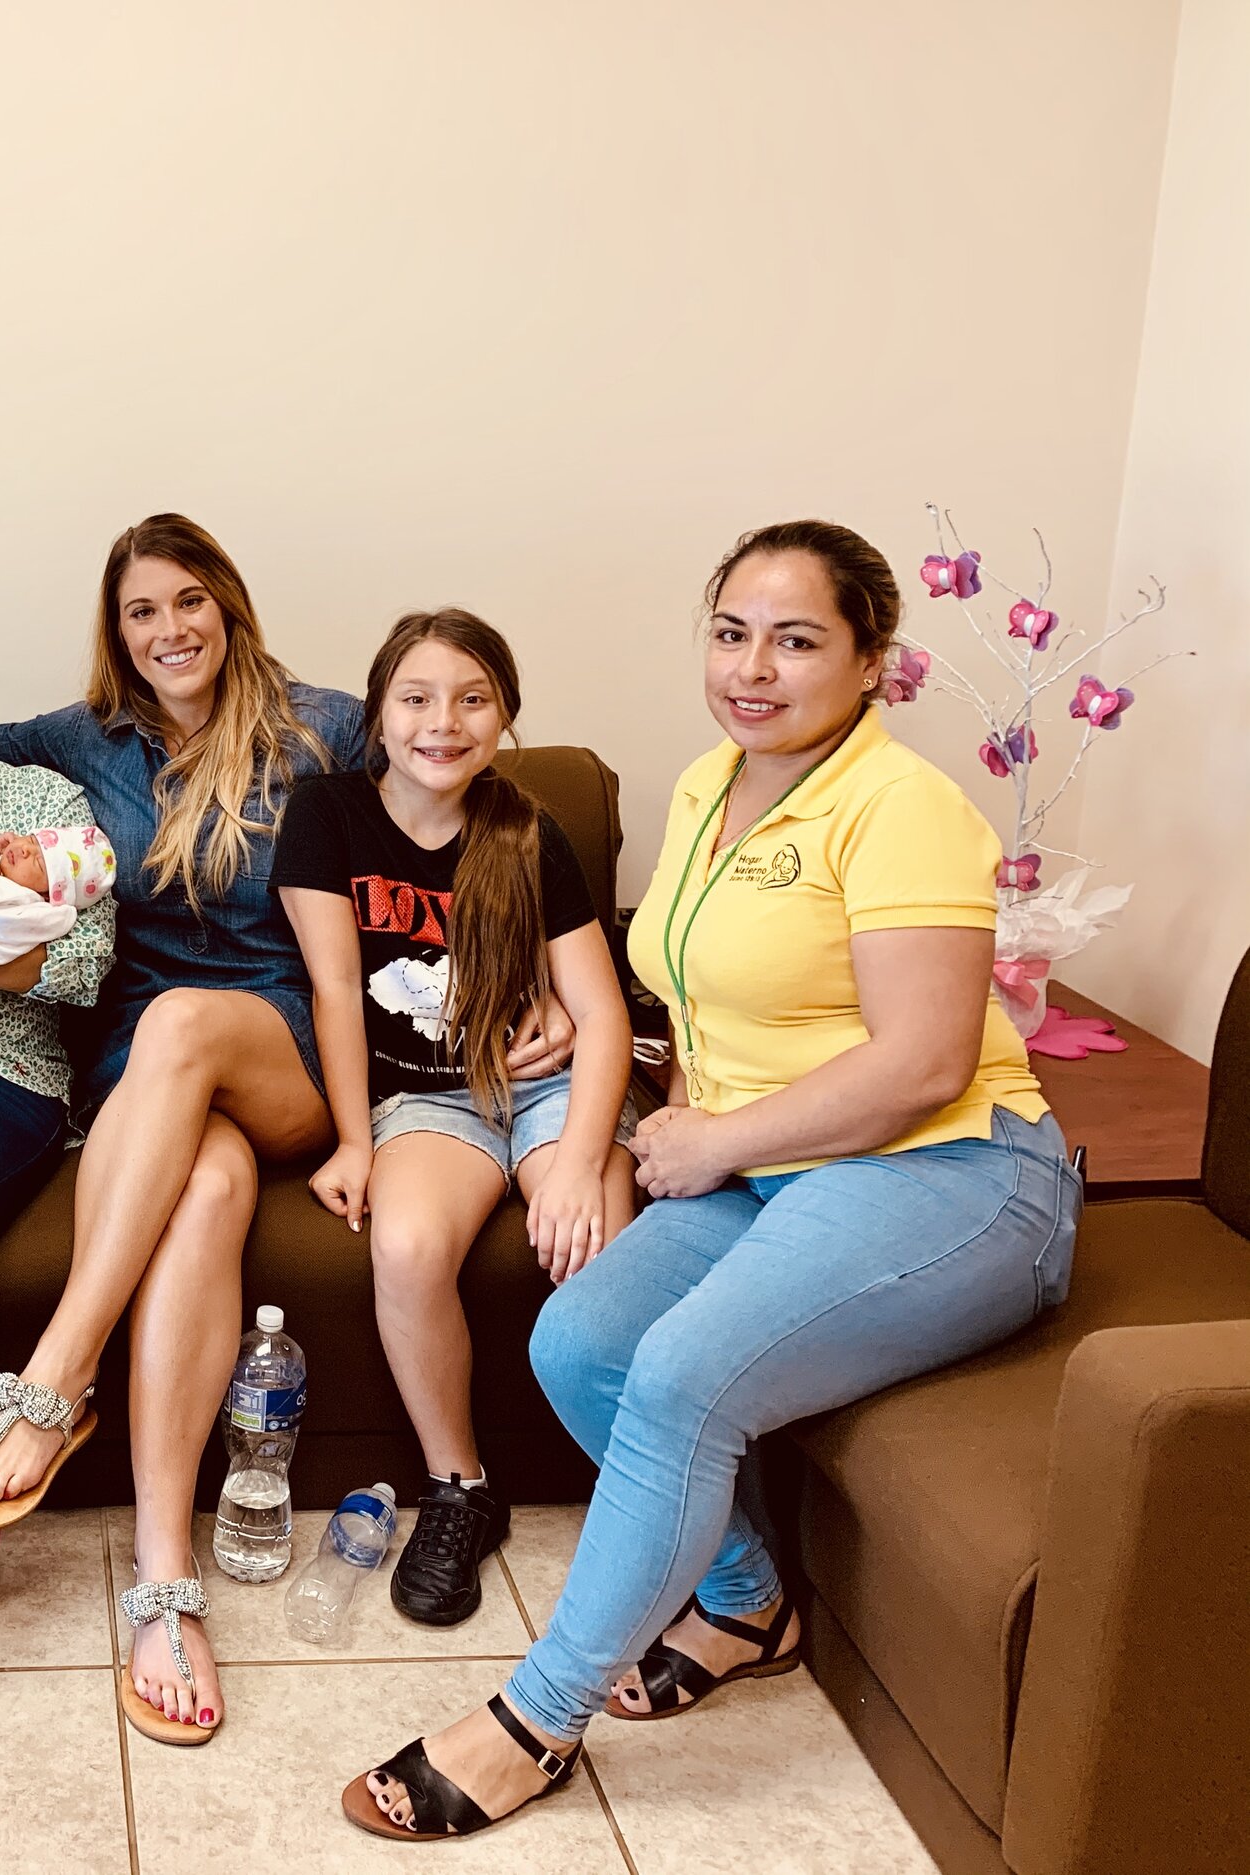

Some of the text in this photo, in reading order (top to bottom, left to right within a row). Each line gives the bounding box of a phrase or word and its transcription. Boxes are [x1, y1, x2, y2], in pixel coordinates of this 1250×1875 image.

[738, 854, 763, 866] Hogar
[734, 865, 767, 875] Materno
[352, 877, 452, 945] LOV
[398, 1060, 420, 1072] GLOBAL
